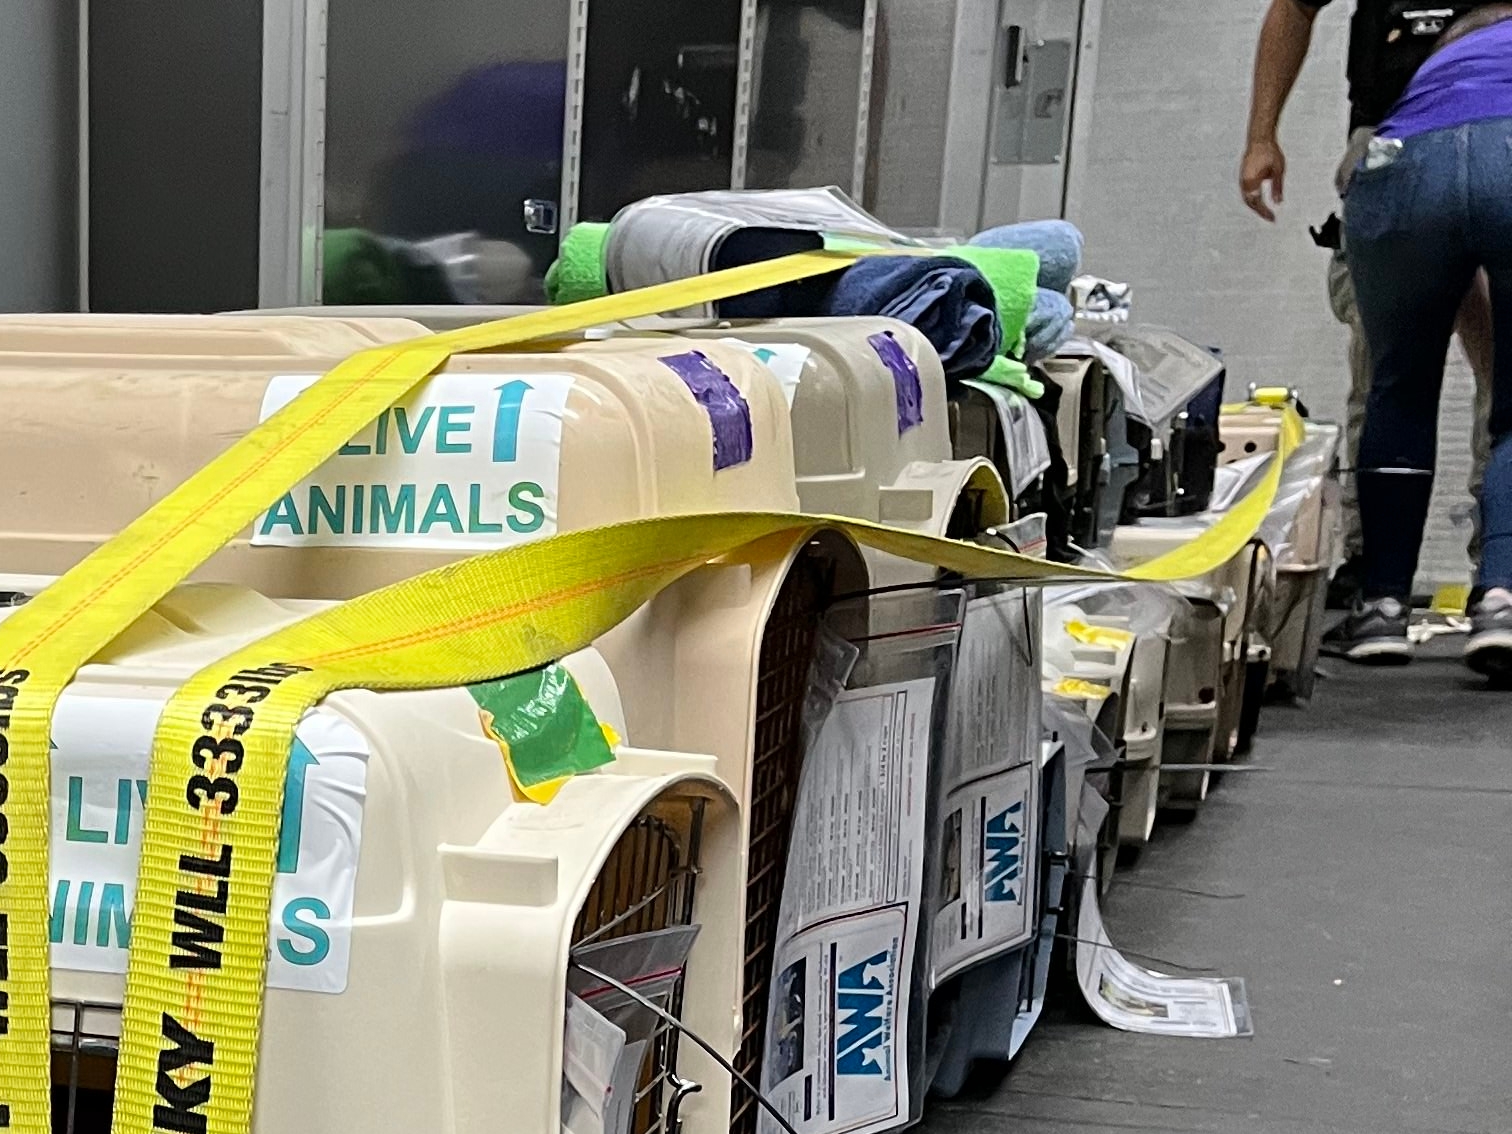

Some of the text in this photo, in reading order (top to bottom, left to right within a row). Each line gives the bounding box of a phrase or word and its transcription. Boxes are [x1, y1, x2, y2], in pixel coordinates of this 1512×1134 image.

[259, 481, 545, 535] ANIMALS
[168, 844, 233, 971] WLL
[985, 800, 1023, 903] AWA
[837, 950, 888, 1074] AWA
